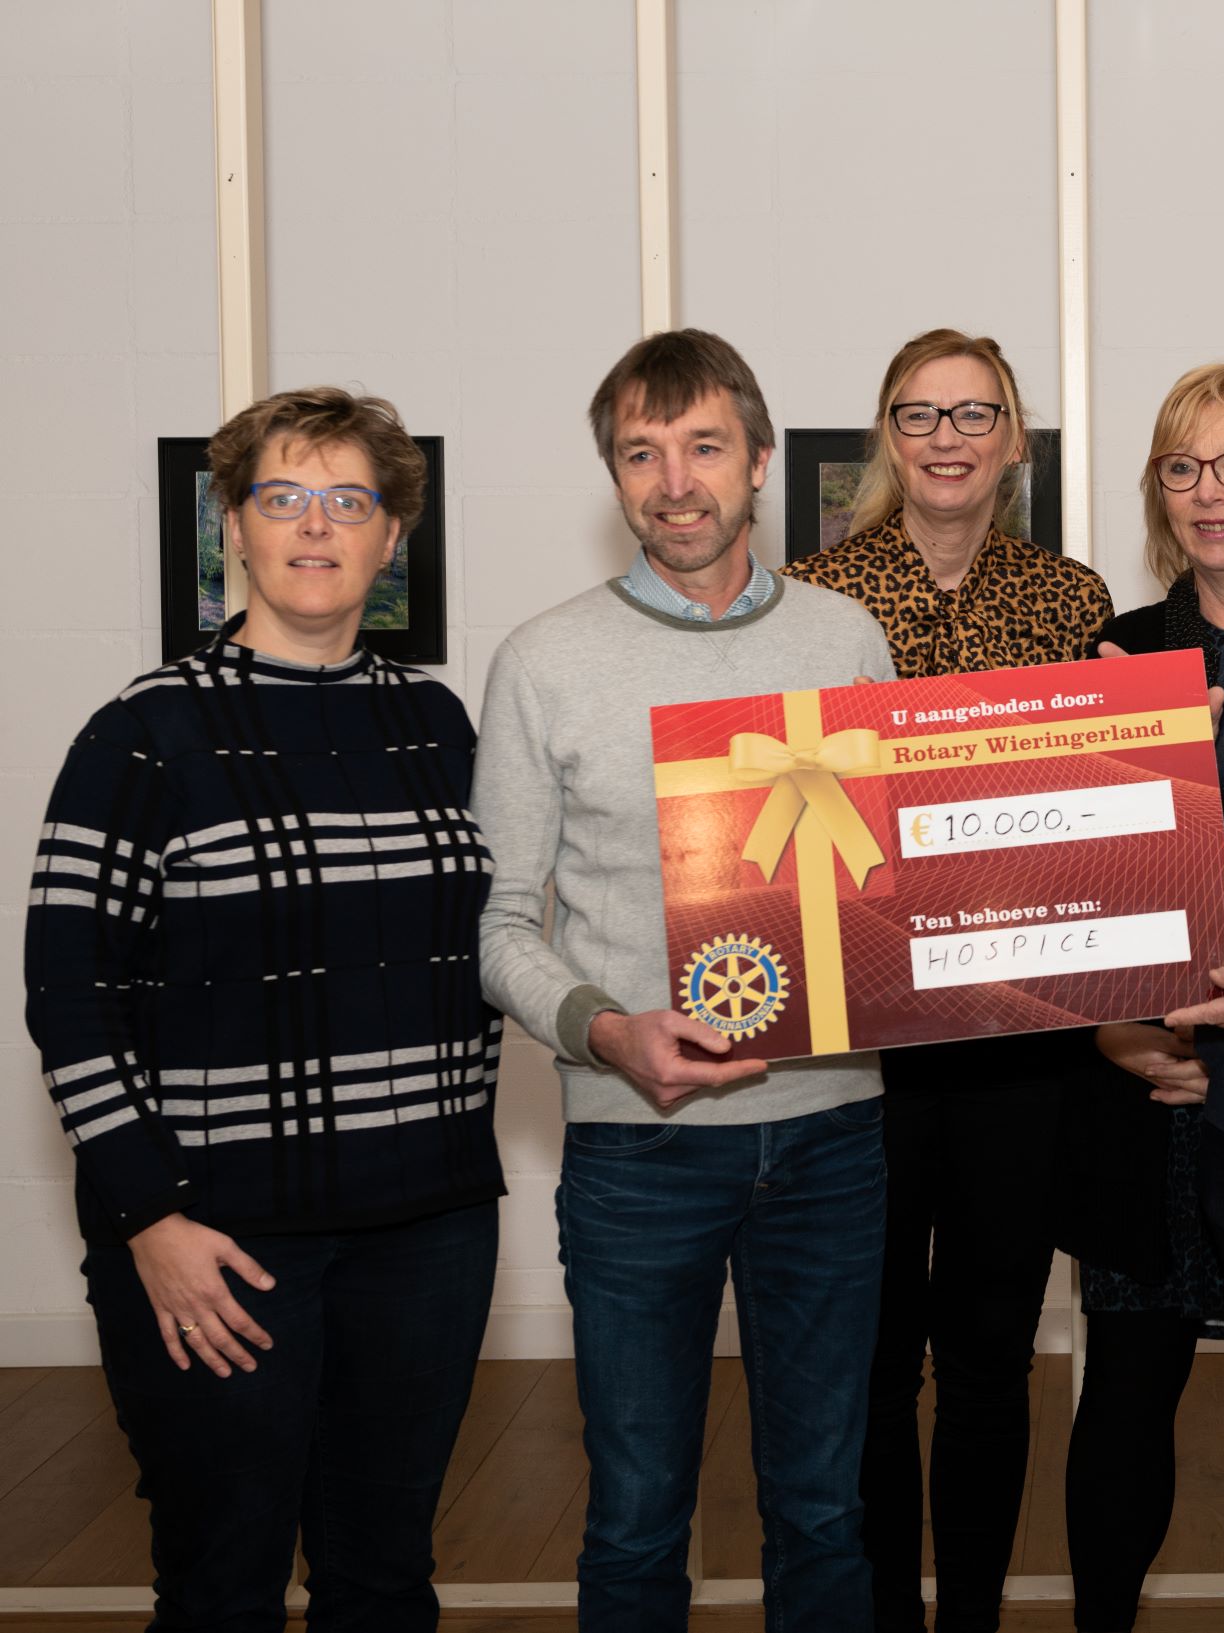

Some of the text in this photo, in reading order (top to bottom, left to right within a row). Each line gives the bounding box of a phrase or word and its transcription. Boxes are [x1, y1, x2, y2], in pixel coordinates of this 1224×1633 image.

[891, 691, 1105, 725] U aangeboden door:
[893, 719, 1166, 764] Rotary Wieringerland
[909, 812, 935, 847] €
[944, 808, 1097, 842] 10.000,-
[910, 899, 1102, 931] Ten behoeve van:
[708, 944, 755, 961] ROTARY
[928, 930, 1100, 972] HOSPICE
[698, 1000, 775, 1031] INTERNATIONAL
